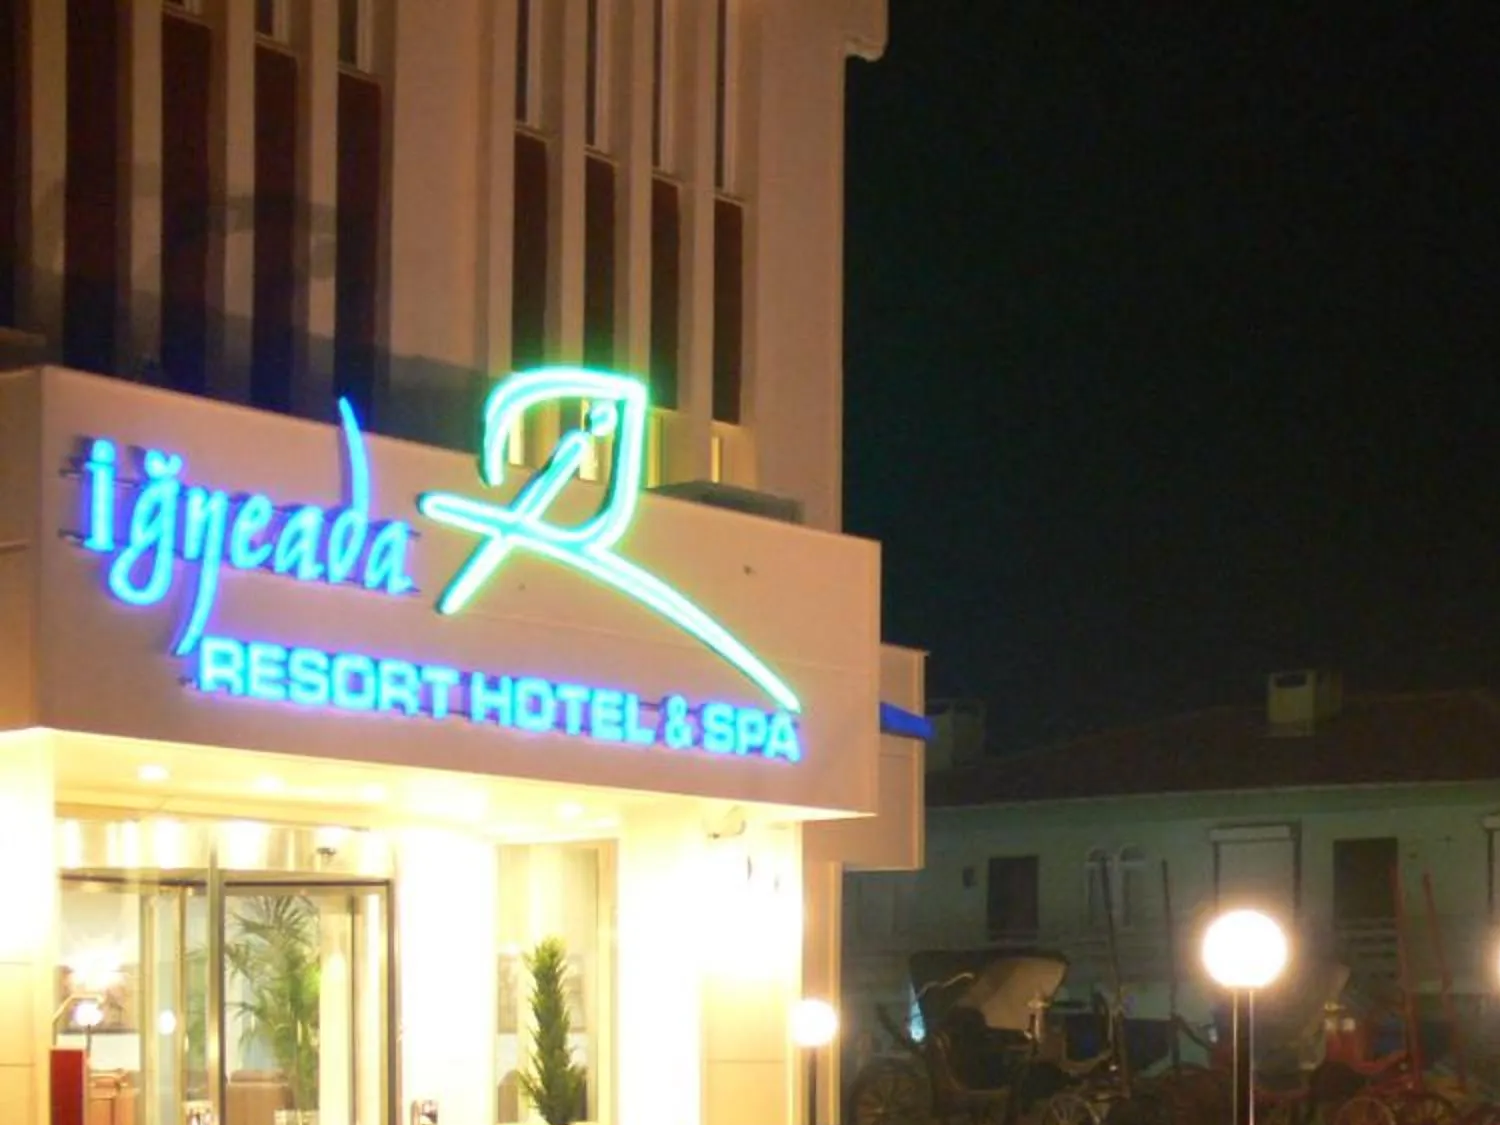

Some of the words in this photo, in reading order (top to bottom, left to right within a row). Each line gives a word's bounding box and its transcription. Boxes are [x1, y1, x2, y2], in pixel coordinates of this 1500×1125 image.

[199, 634, 460, 719] RESORT
[470, 671, 656, 745] HOTEL
[662, 694, 693, 749] &
[702, 702, 801, 764] SPA
